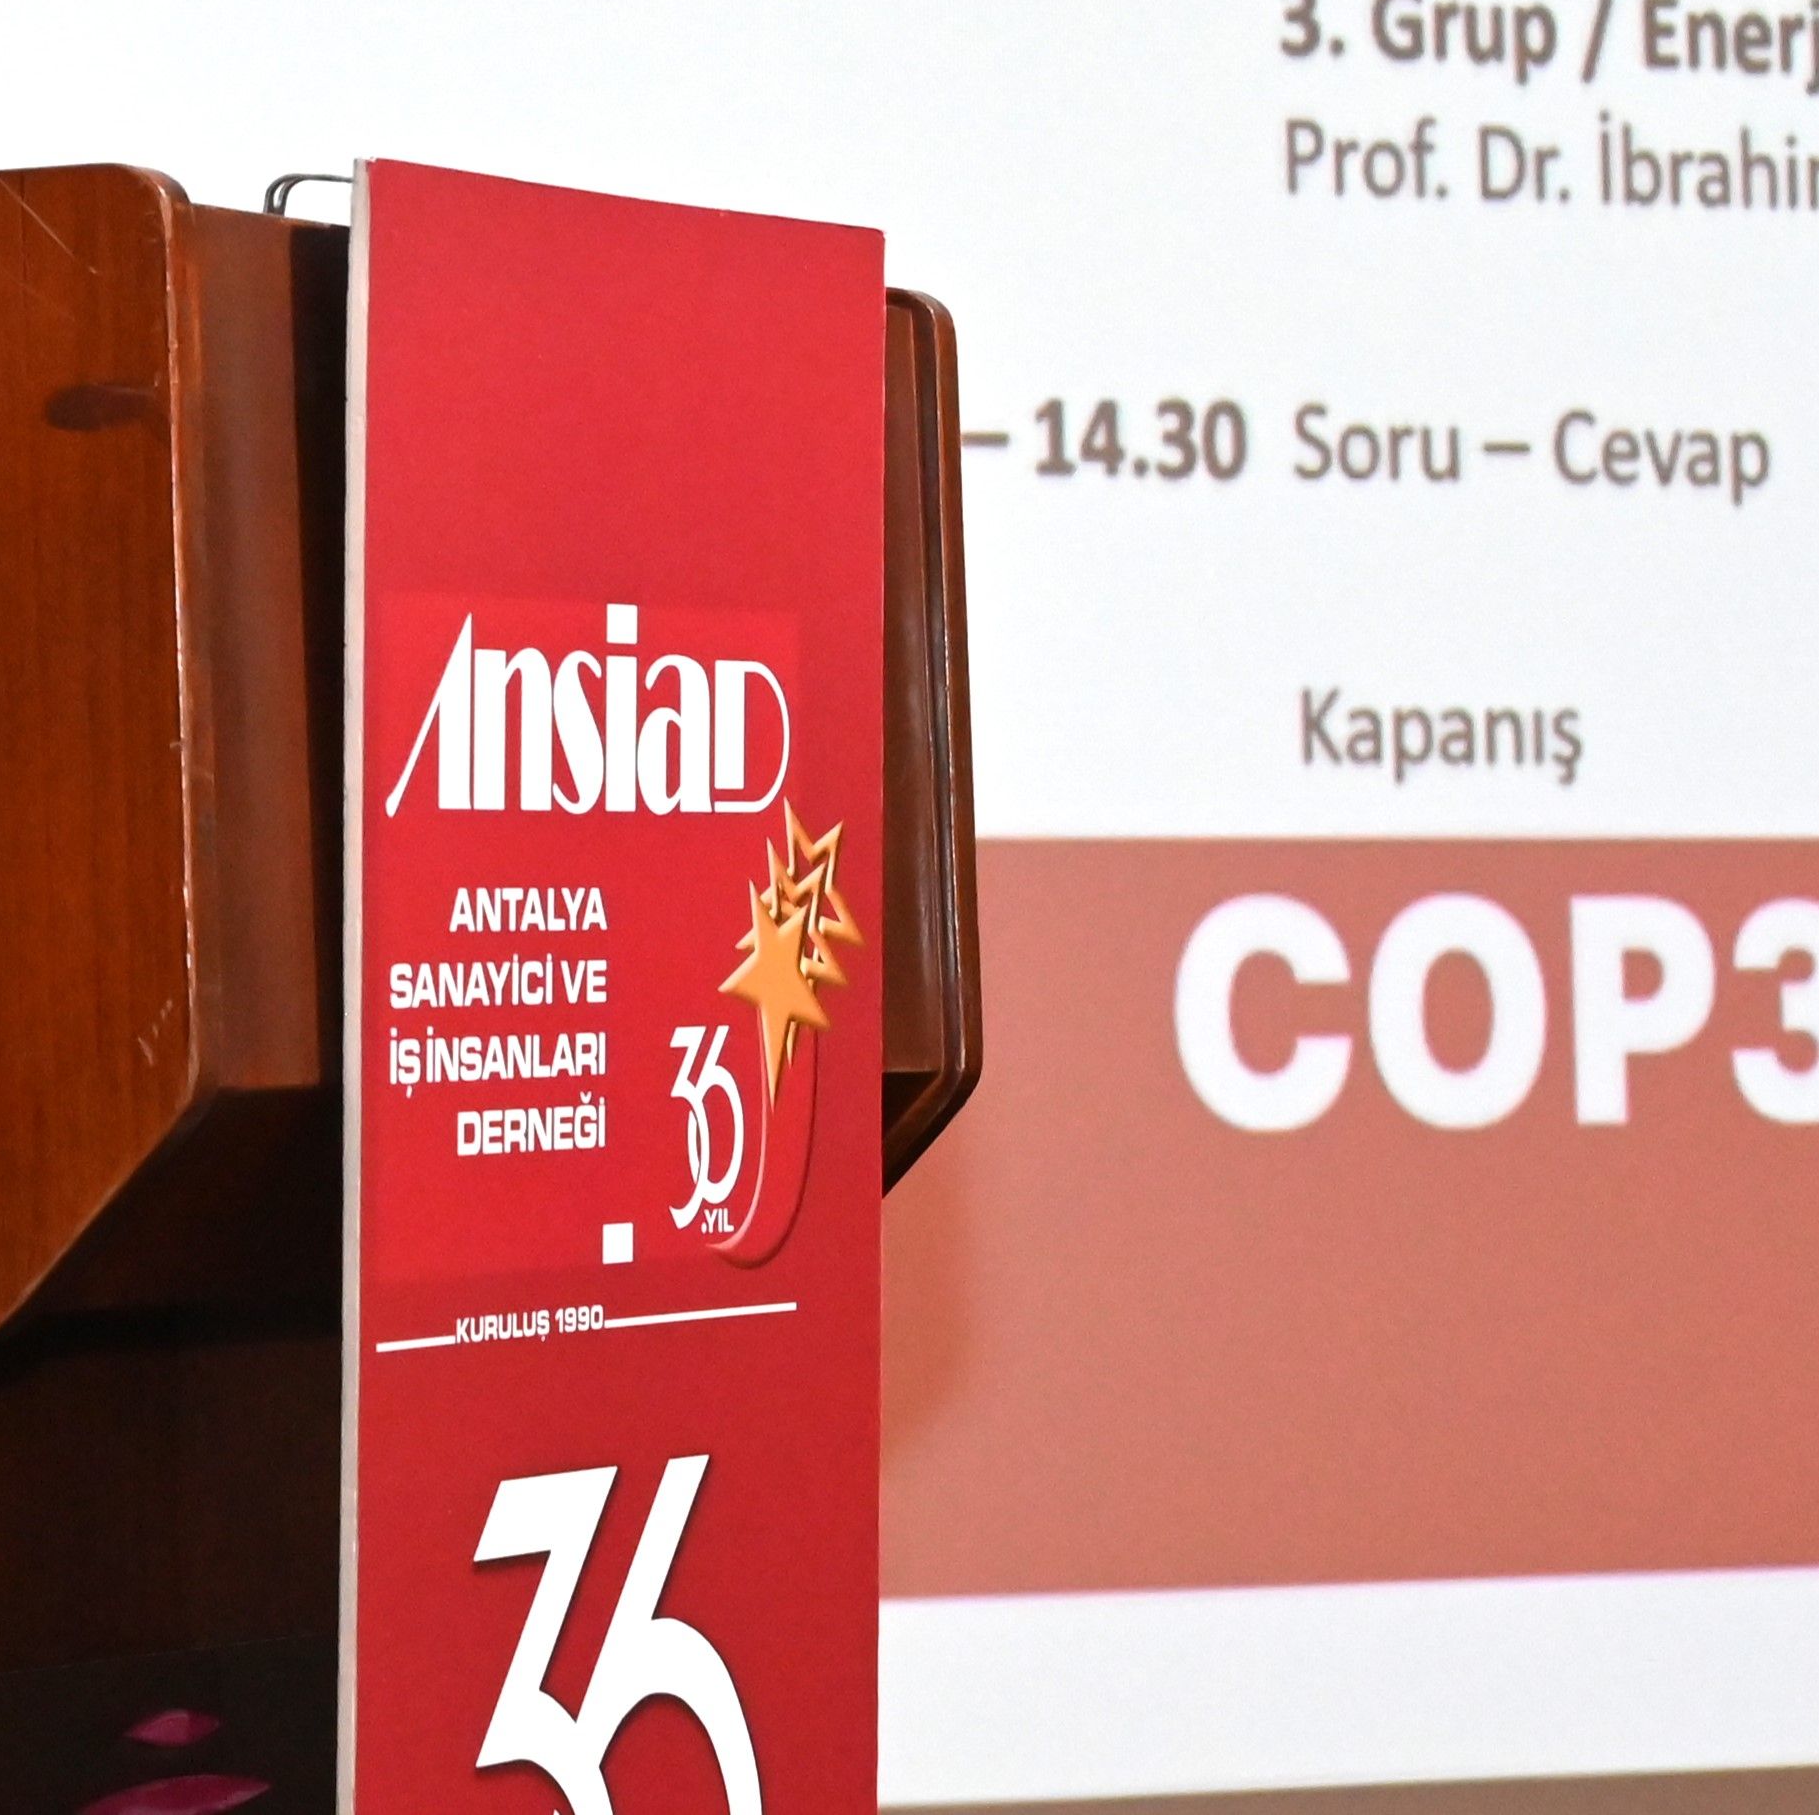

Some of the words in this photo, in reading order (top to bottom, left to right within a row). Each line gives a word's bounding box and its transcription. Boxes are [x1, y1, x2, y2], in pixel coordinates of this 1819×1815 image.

[1285, 116, 1448, 199] Prof.
[1478, 124, 1570, 203] Dr.
[1035, 397, 1248, 482] 14.30
[1294, 402, 1461, 483] Soru
[1553, 408, 1770, 507] Cevap
[1301, 688, 1583, 786] Kapanış
[448, 887, 608, 933] ANTALYA
[389, 952, 554, 1010] SANAYİCİ
[560, 959, 608, 1004] VE
[1174, 893, 1819, 1131] COP3
[389, 1026, 422, 1099] İŞ
[426, 1025, 607, 1084] İNSANLARI
[456, 1091, 606, 1157] DERNEĞİ
[668, 1024, 745, 1230] 36
[456, 1309, 550, 1343] KURULUŞ
[554, 1304, 604, 1334] 1990
